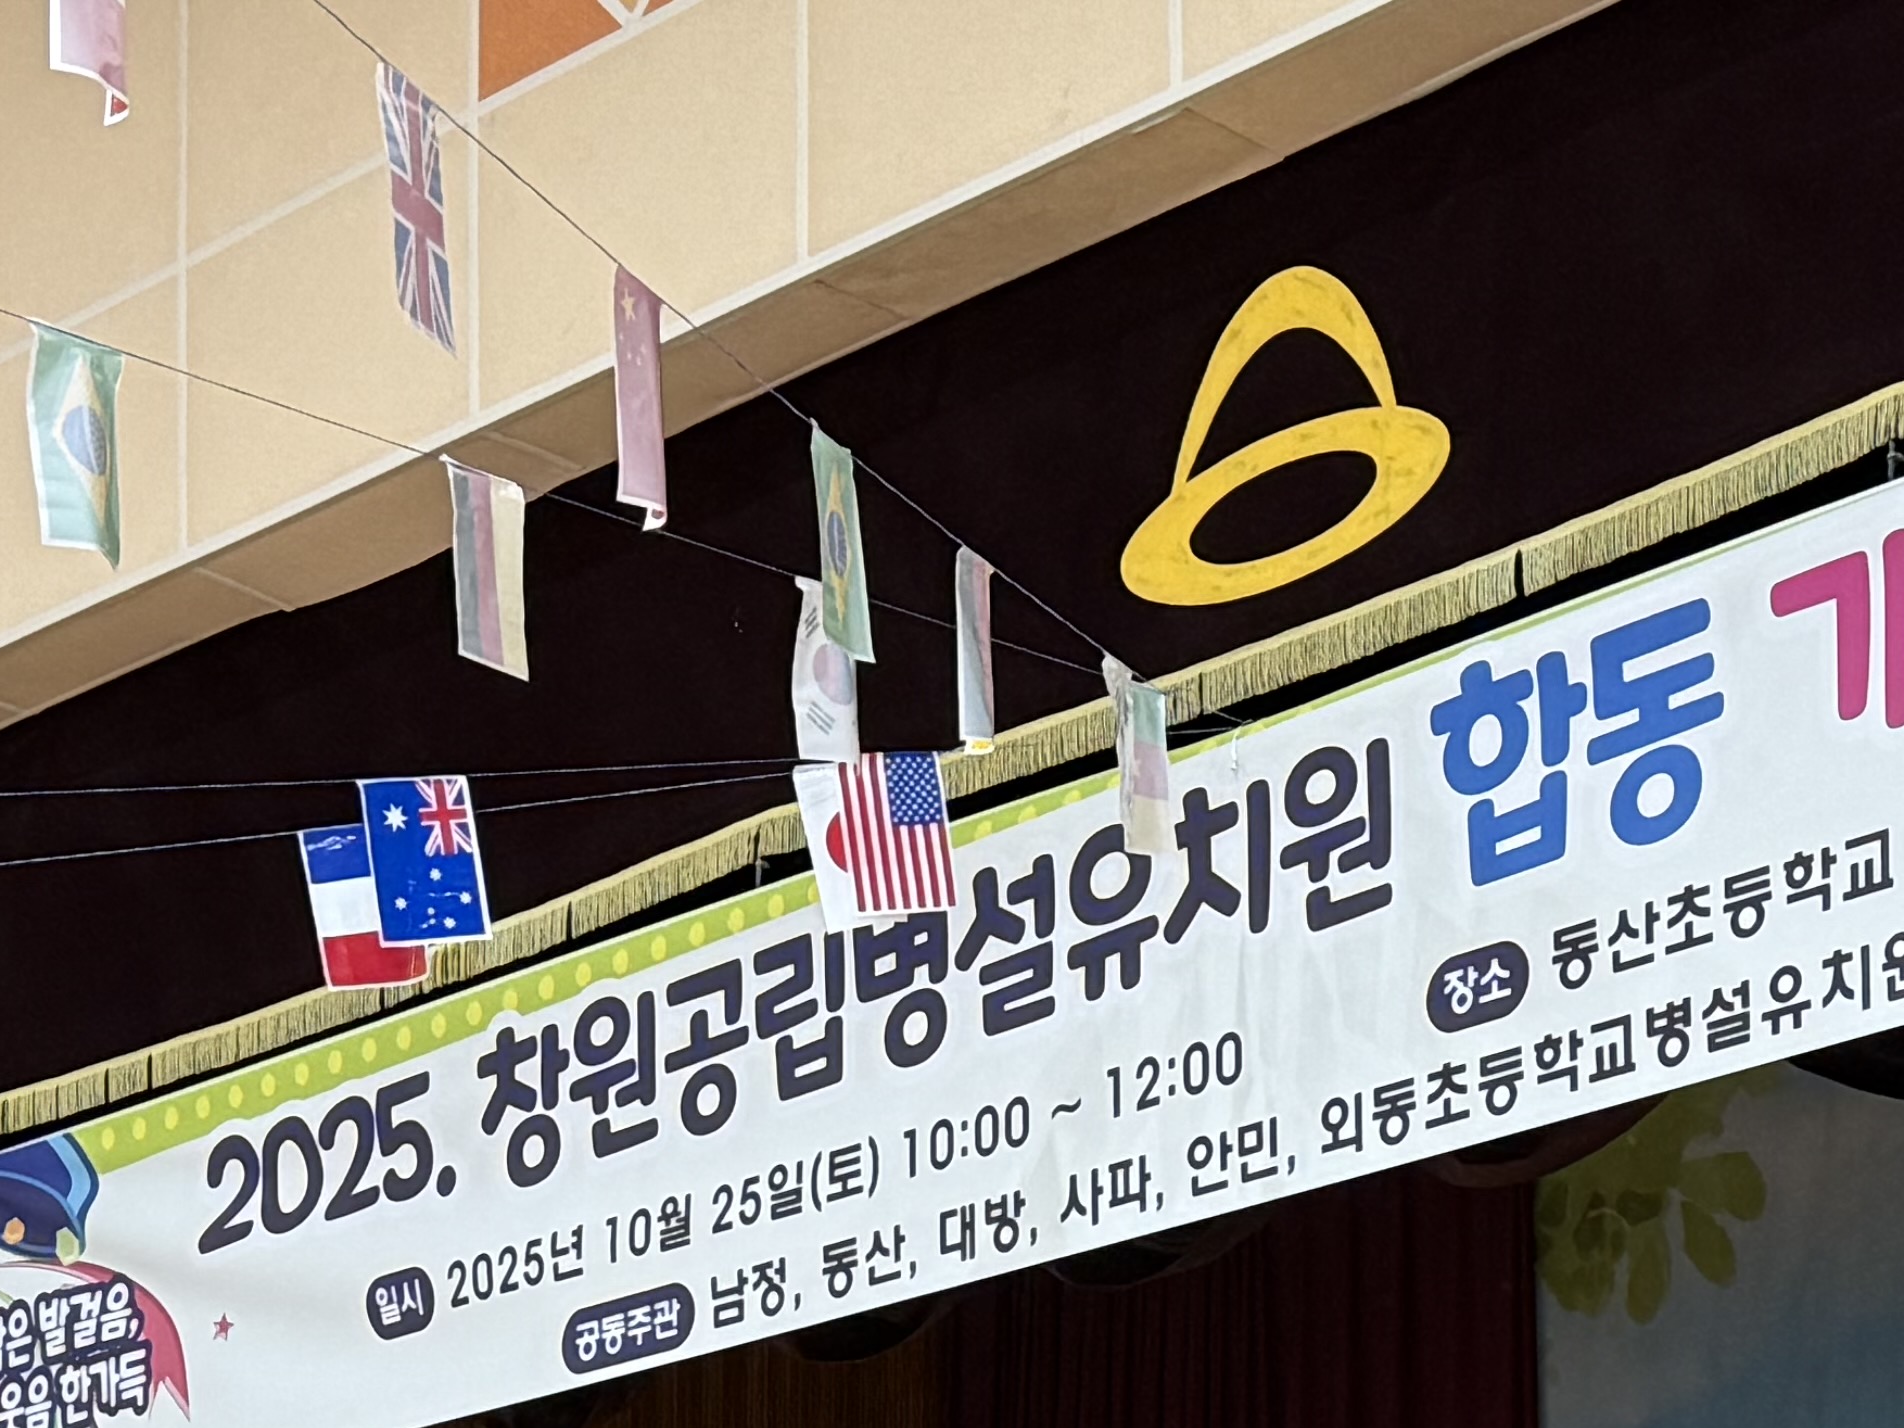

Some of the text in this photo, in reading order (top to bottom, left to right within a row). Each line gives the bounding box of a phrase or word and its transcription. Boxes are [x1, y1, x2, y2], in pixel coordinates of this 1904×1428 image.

[198, 1070, 458, 1256] 2025.
[477, 736, 1394, 1189] 창원공립병설유치원
[1429, 596, 1725, 887] 합동
[1441, 961, 1514, 1015] 장소
[1551, 826, 1895, 990] 동산초등학교
[375, 1276, 427, 1327] 일시
[447, 1222, 586, 1308] 2025년
[605, 1193, 695, 1265] 10월
[710, 1136, 881, 1235] 25일(토)
[903, 1095, 1031, 1180] 10:00
[1106, 1029, 1244, 1120] 12:00
[574, 1298, 681, 1364] 공동주관
[709, 1254, 802, 1331] 남정,
[822, 1228, 919, 1301] 동산,
[939, 1190, 1040, 1263] 대방,
[1060, 1164, 1164, 1228] 사파,
[1186, 1115, 1298, 1199] 안민,
[39, 1282, 141, 1357] 발걸음,
